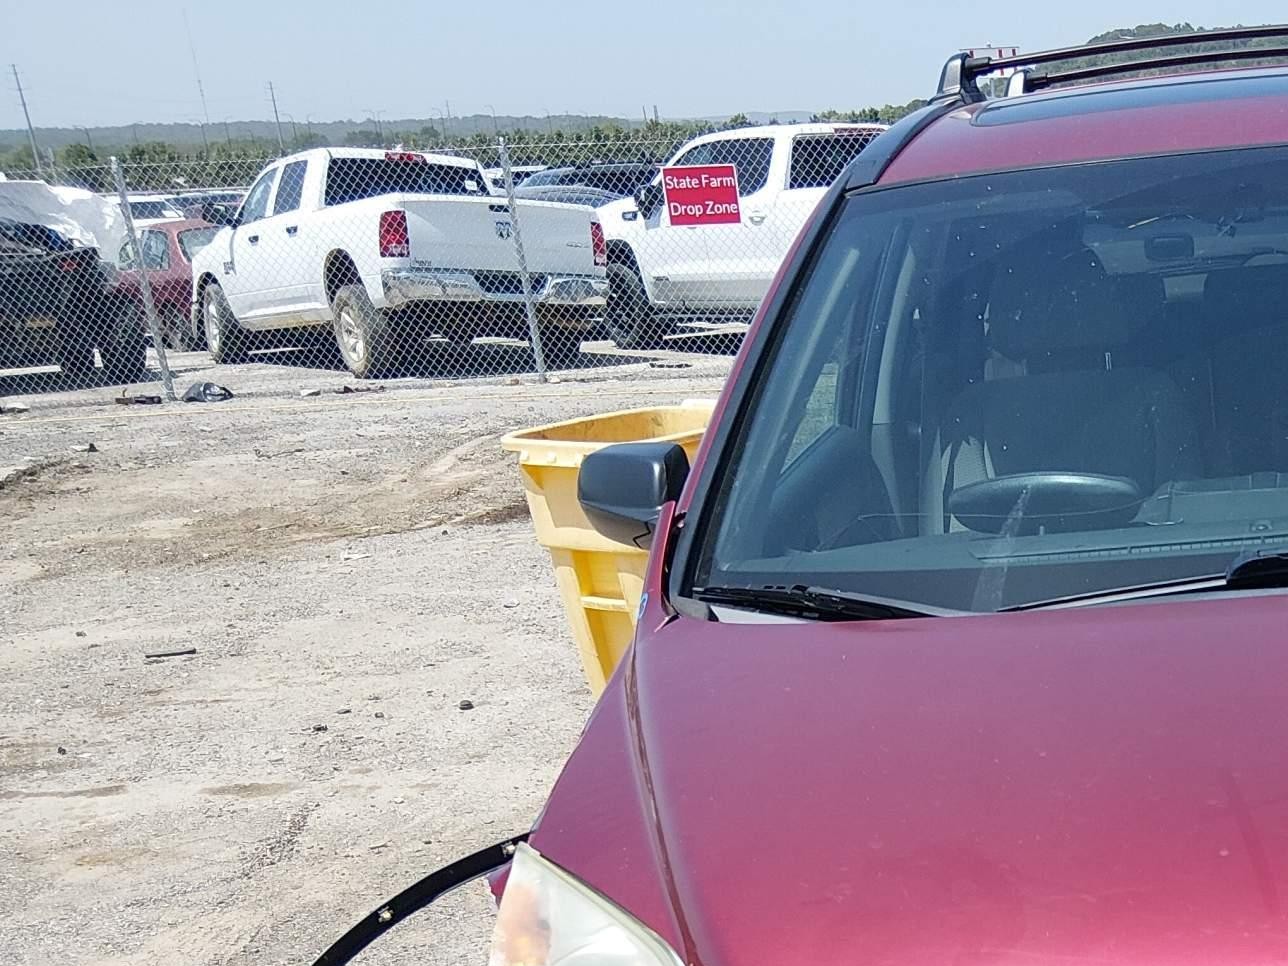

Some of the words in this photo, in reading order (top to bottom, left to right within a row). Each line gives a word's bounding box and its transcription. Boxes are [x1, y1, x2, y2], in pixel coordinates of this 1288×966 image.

[665, 175, 700, 189] State
[701, 174, 735, 188] Farm
[670, 202, 704, 218] Drop
[705, 201, 739, 215] Zone
